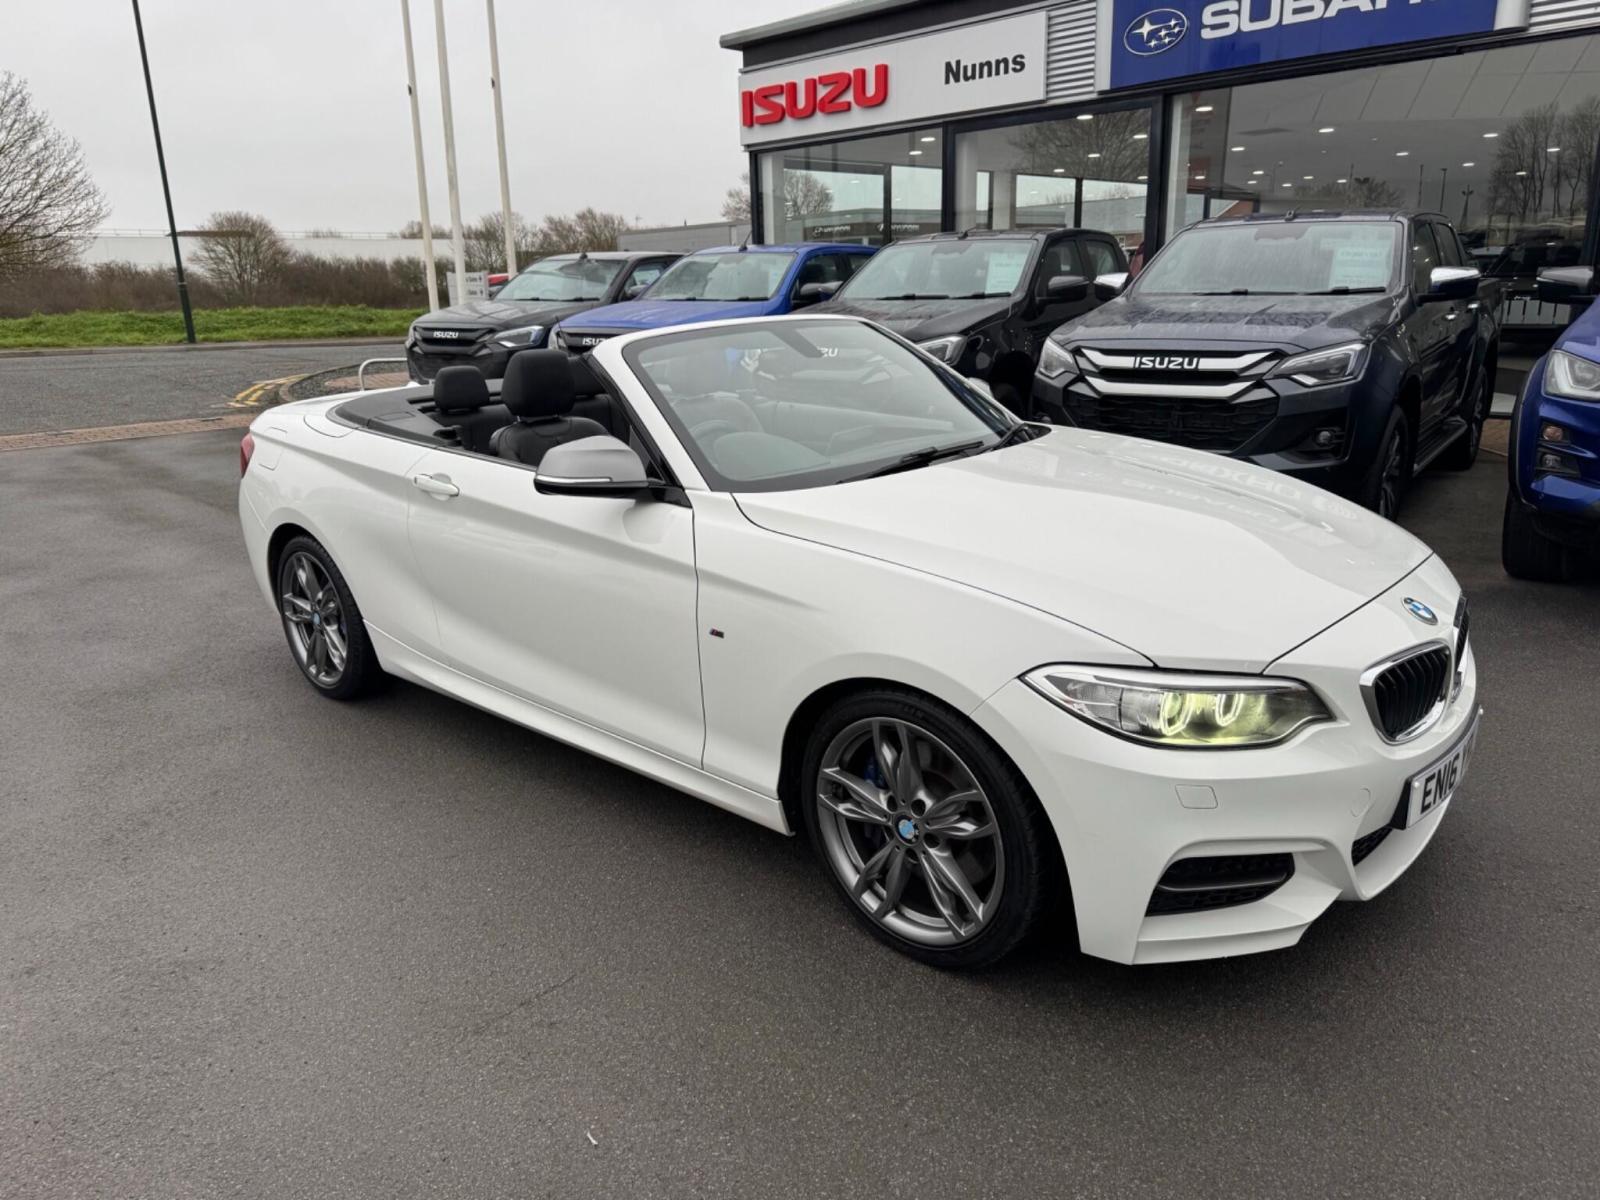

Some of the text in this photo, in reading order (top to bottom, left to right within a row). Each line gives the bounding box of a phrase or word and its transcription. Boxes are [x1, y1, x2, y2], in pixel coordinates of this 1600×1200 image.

[944, 54, 1026, 85] Nunns
[742, 64, 888, 127] ISUZU
[1135, 356, 1198, 369] ISUZU
